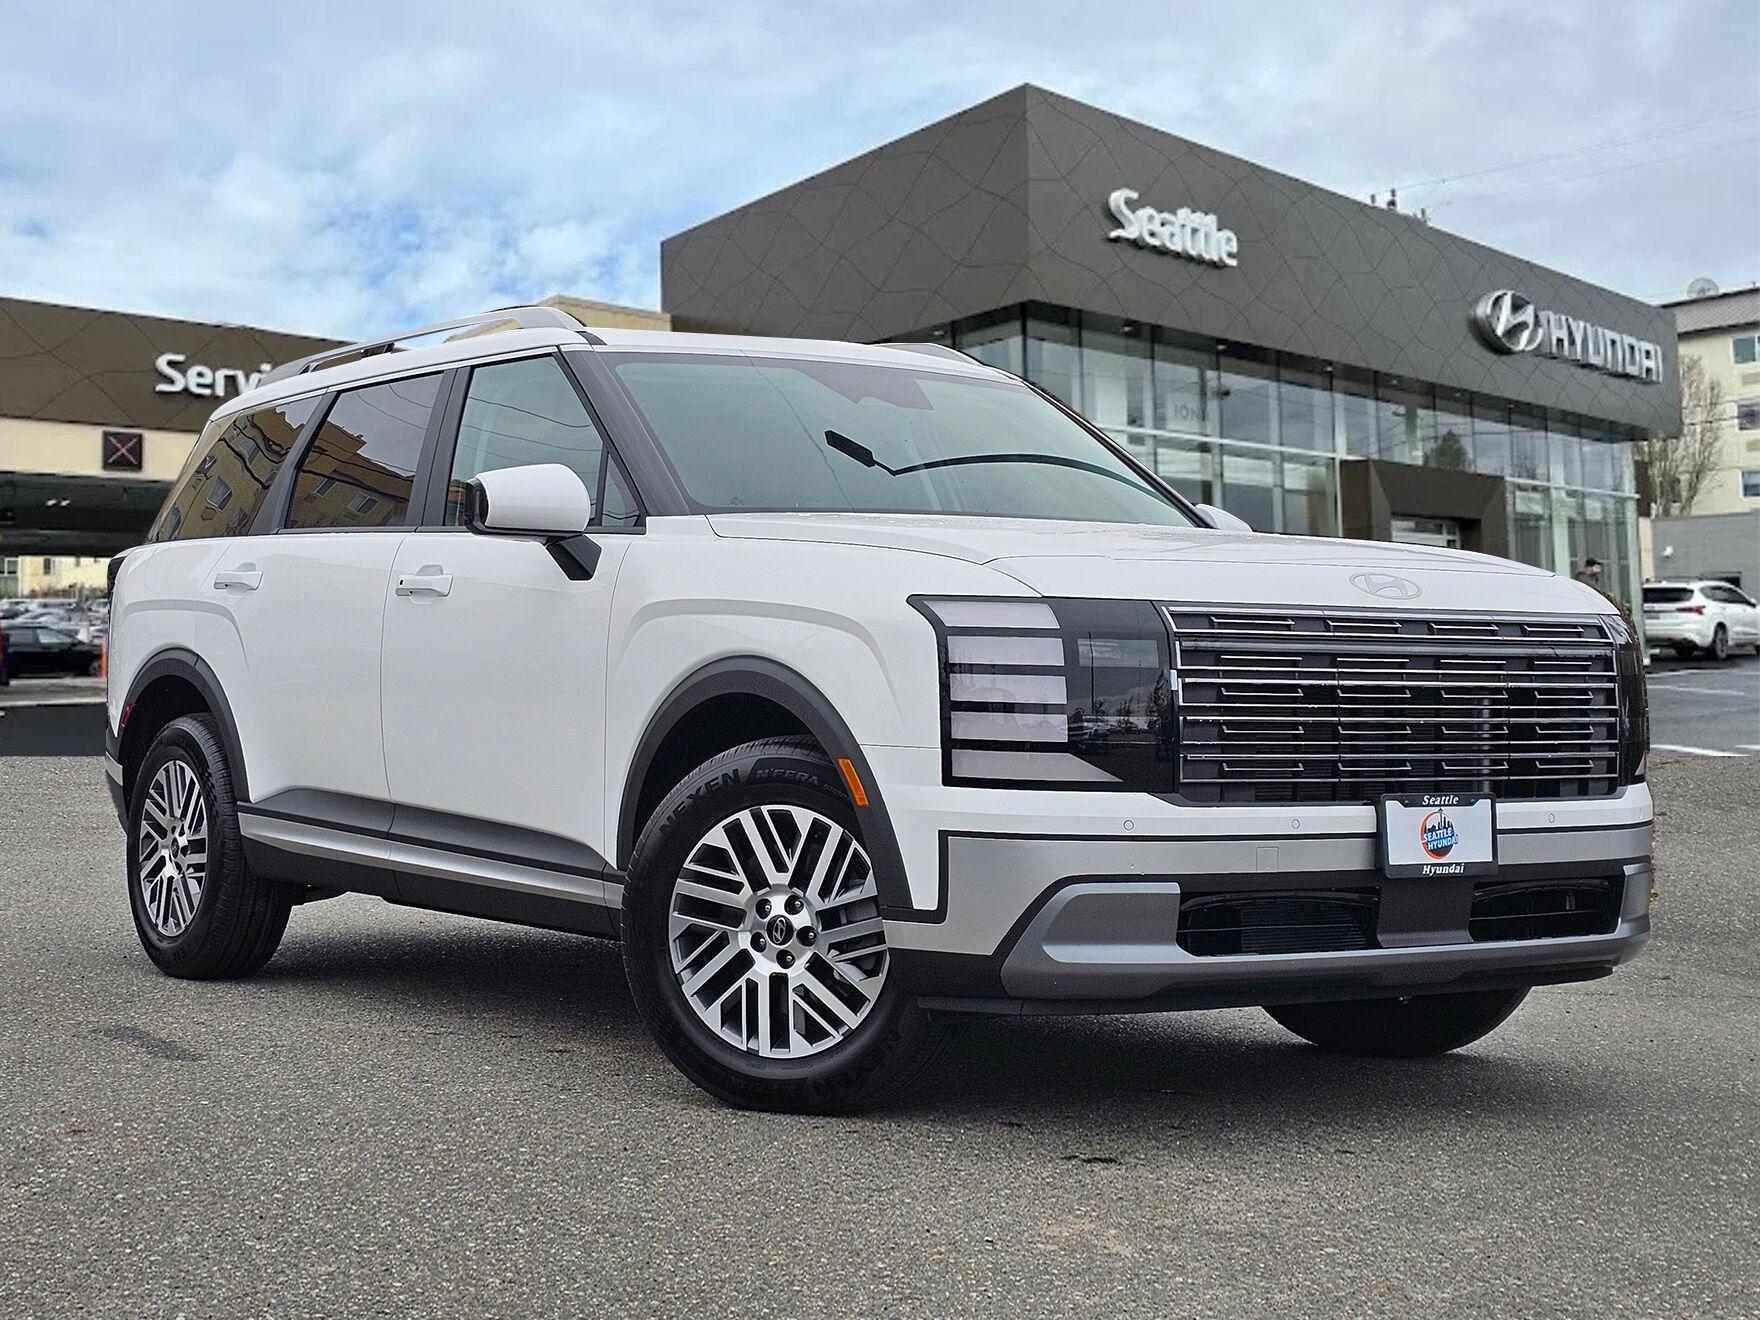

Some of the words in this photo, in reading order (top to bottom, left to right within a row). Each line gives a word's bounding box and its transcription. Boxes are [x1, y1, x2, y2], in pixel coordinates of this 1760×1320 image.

[1109, 187, 1239, 268] Seattle
[1544, 310, 1663, 383] HYUNDAI
[659, 768, 740, 834] NEXEN
[1422, 795, 1459, 806] Seattle
[1421, 827, 1453, 843] SEATTLE
[1427, 833, 1460, 850] HYUNDAI
[1422, 863, 1465, 876] Hyundai
